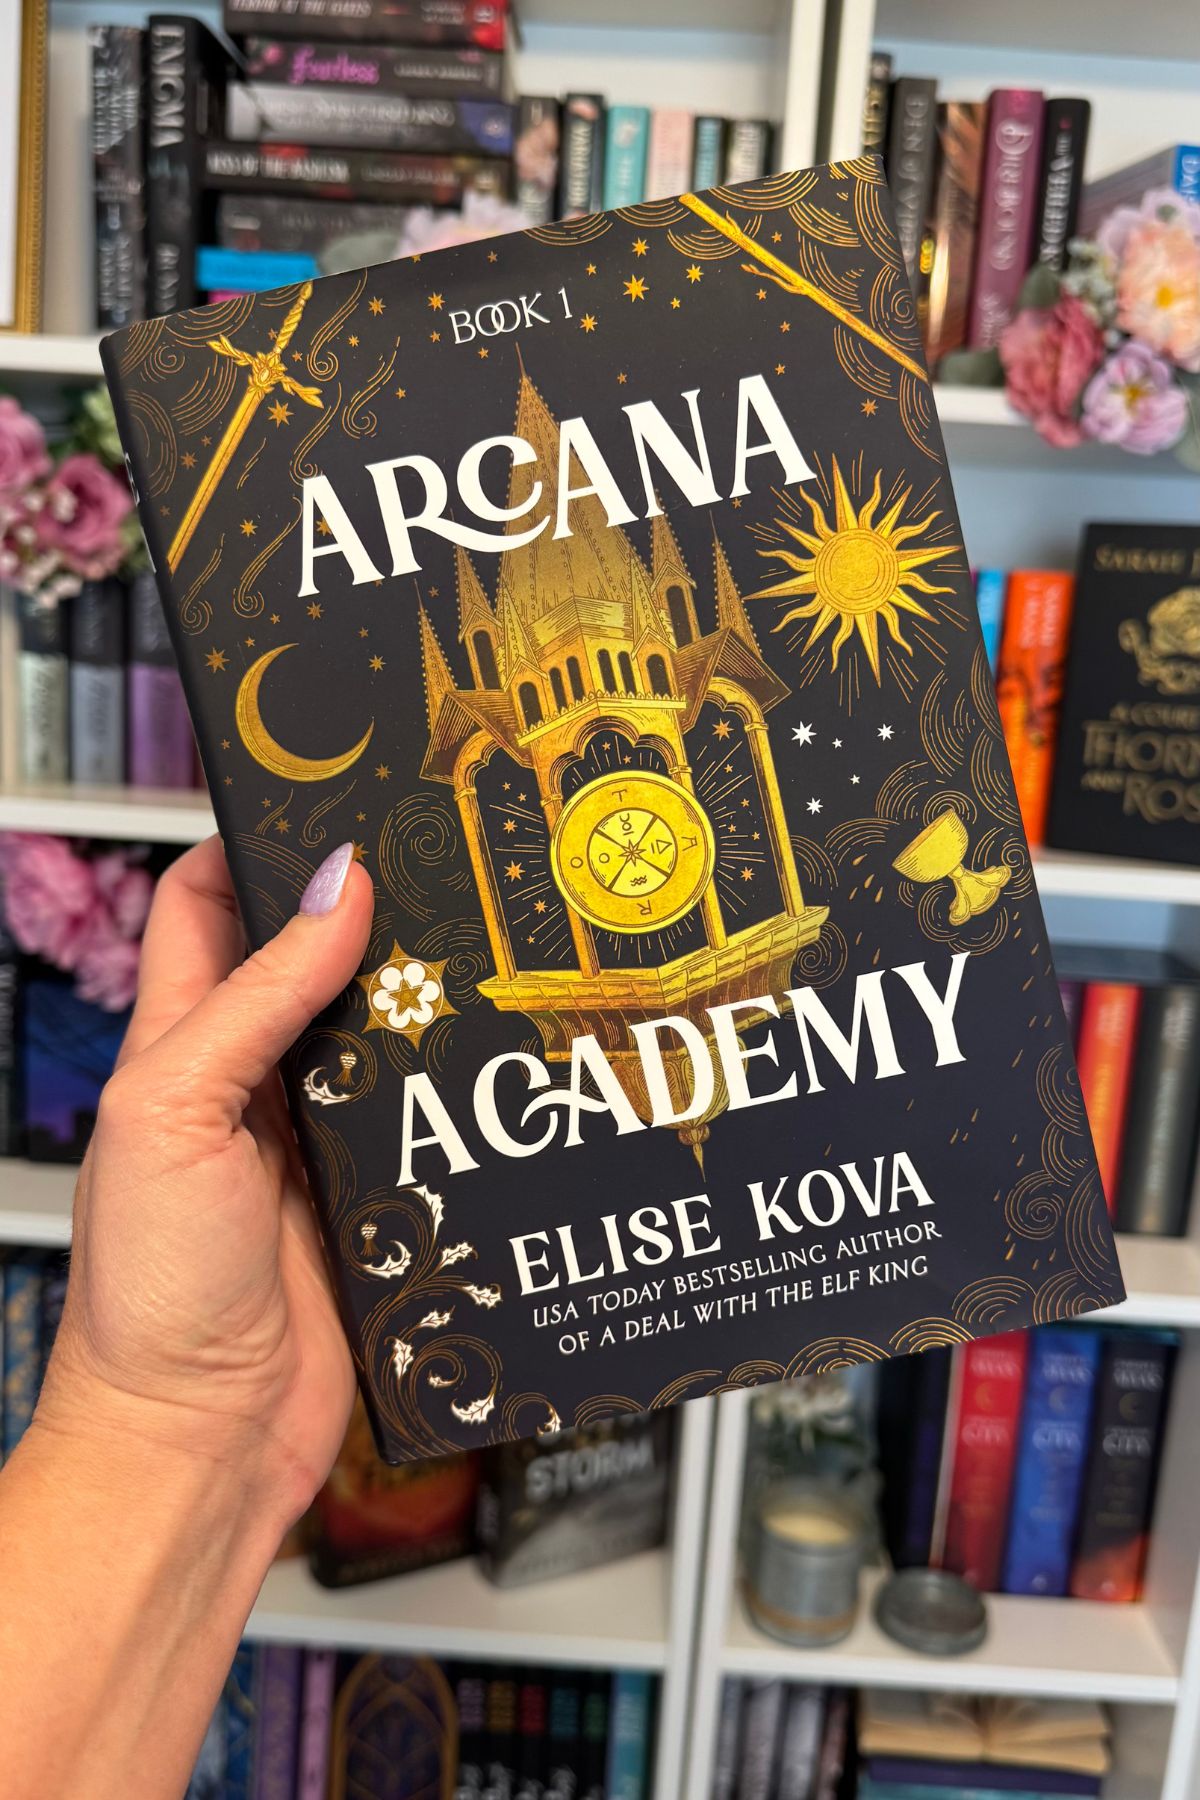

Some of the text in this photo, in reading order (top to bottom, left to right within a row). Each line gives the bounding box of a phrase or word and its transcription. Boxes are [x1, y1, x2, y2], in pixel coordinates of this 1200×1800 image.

[448, 287, 573, 345] BOOK 1
[297, 373, 818, 598] ARCANA
[396, 950, 971, 1187] ACADEMY
[508, 1151, 935, 1296] ELISE KOVA
[533, 1221, 943, 1328] USA TODAY BESTSELLING AUTHOR
[558, 1255, 929, 1355] OF A DEAL WITH THE ELF KING
